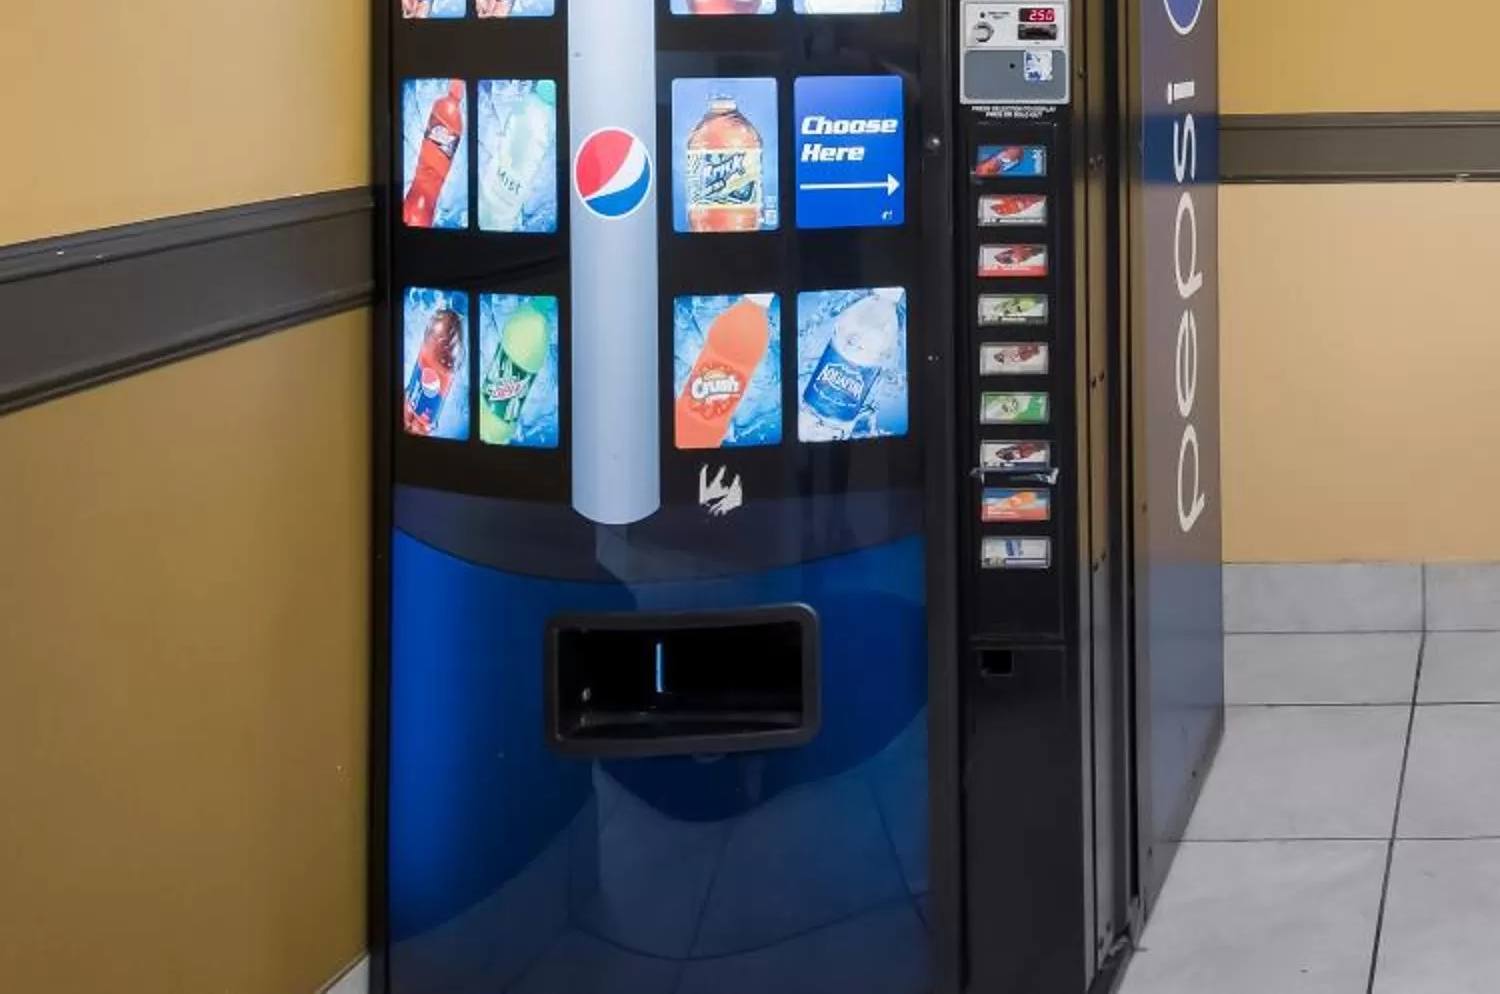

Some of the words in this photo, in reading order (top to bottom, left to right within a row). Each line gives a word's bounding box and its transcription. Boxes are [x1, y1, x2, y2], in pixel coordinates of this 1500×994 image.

[801, 116, 898, 135] Choose
[801, 143, 864, 162] Here
[1167, 81, 1205, 534] pepsi
